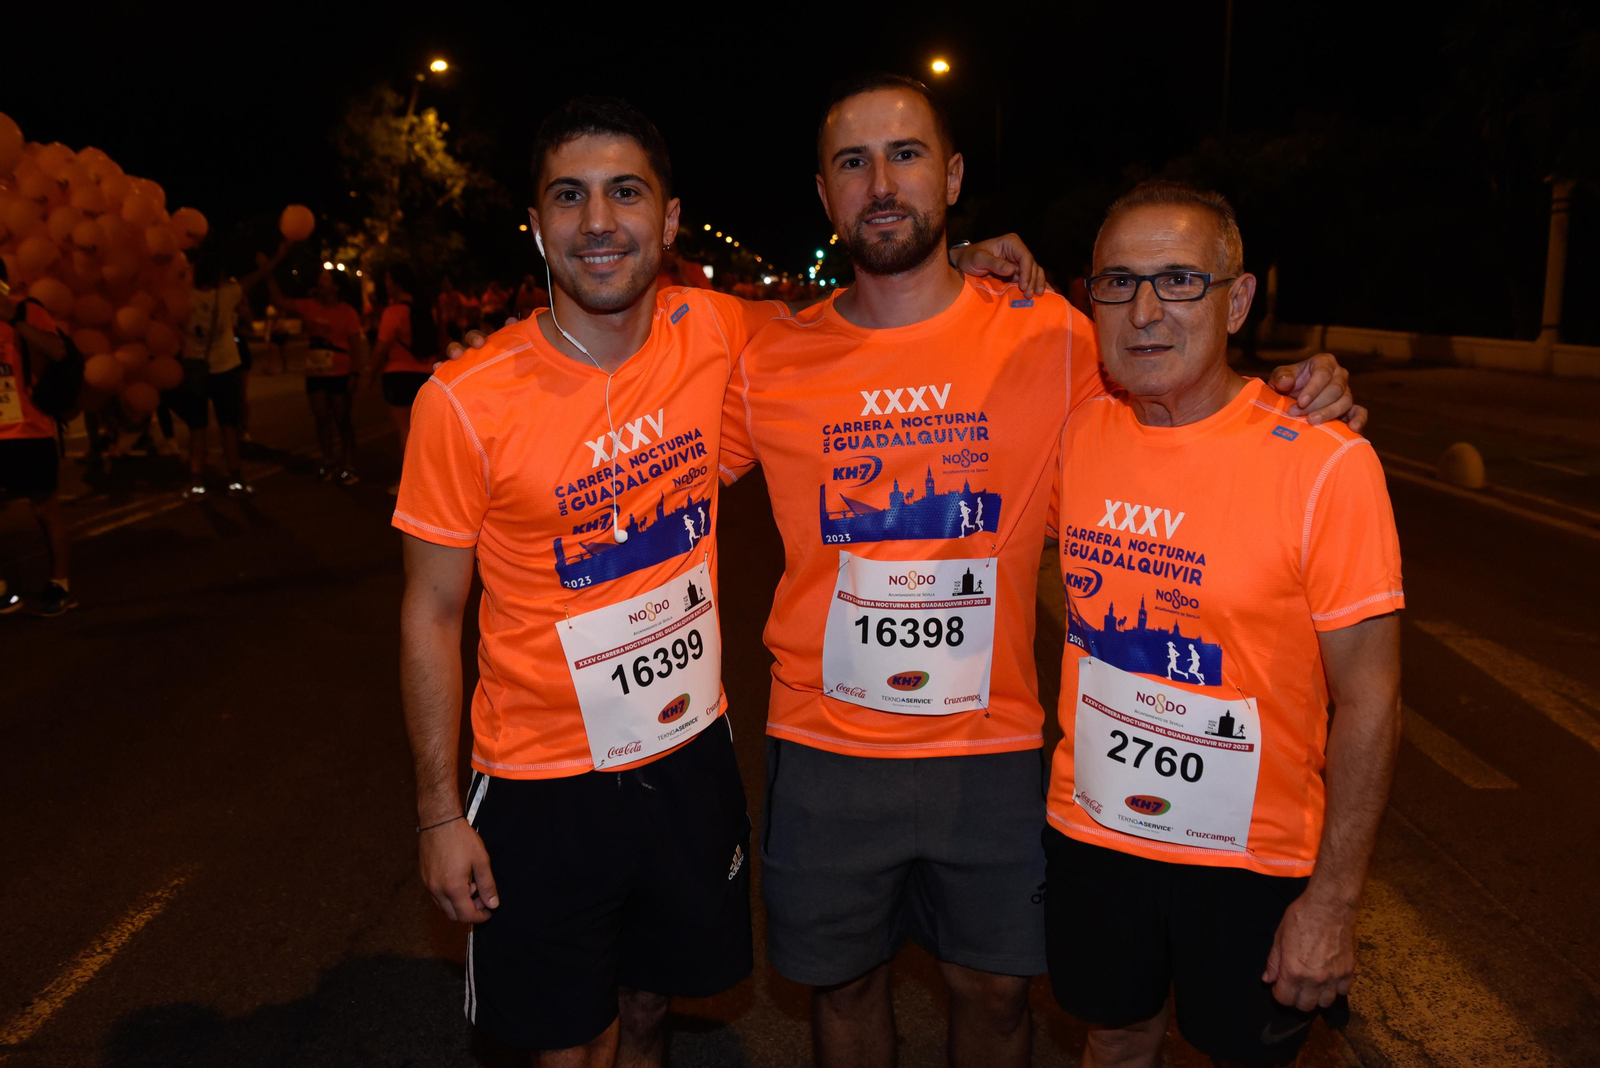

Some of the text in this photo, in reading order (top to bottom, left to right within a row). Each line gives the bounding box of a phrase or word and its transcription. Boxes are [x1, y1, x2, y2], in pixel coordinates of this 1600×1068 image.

[860, 383, 952, 416] XXXV
[584, 408, 664, 468] XXXV
[822, 411, 988, 435] CARRERA NOCTURNA
[833, 426, 990, 451] GUADALQUIVIR
[555, 428, 703, 498] CARRERA NOCTURNA
[571, 441, 708, 511] GUADALQUIVIR
[558, 499, 569, 516] DEL
[1097, 499, 1186, 539] XXXV
[826, 533, 851, 543] 2023
[1066, 525, 1206, 566] CARRERA NOCTURNA
[1070, 542, 1203, 586] GUADALQUIVIR
[564, 575, 592, 588] 2023
[855, 615, 964, 648] 16398
[578, 656, 597, 667] XXXV
[597, 647, 625, 661] CARRERA
[624, 635, 655, 651] NOCTURNA
[611, 629, 703, 695] 16399
[944, 694, 981, 706] Cruzcampo
[1098, 704, 1120, 719] CARRERA
[1121, 715, 1155, 731] NOCTURNA
[1156, 726, 1166, 734] DEL
[1167, 731, 1217, 747] GUADALQUIVIR
[1107, 729, 1204, 782] 2760
[1186, 829, 1236, 843] Cruzcampo
